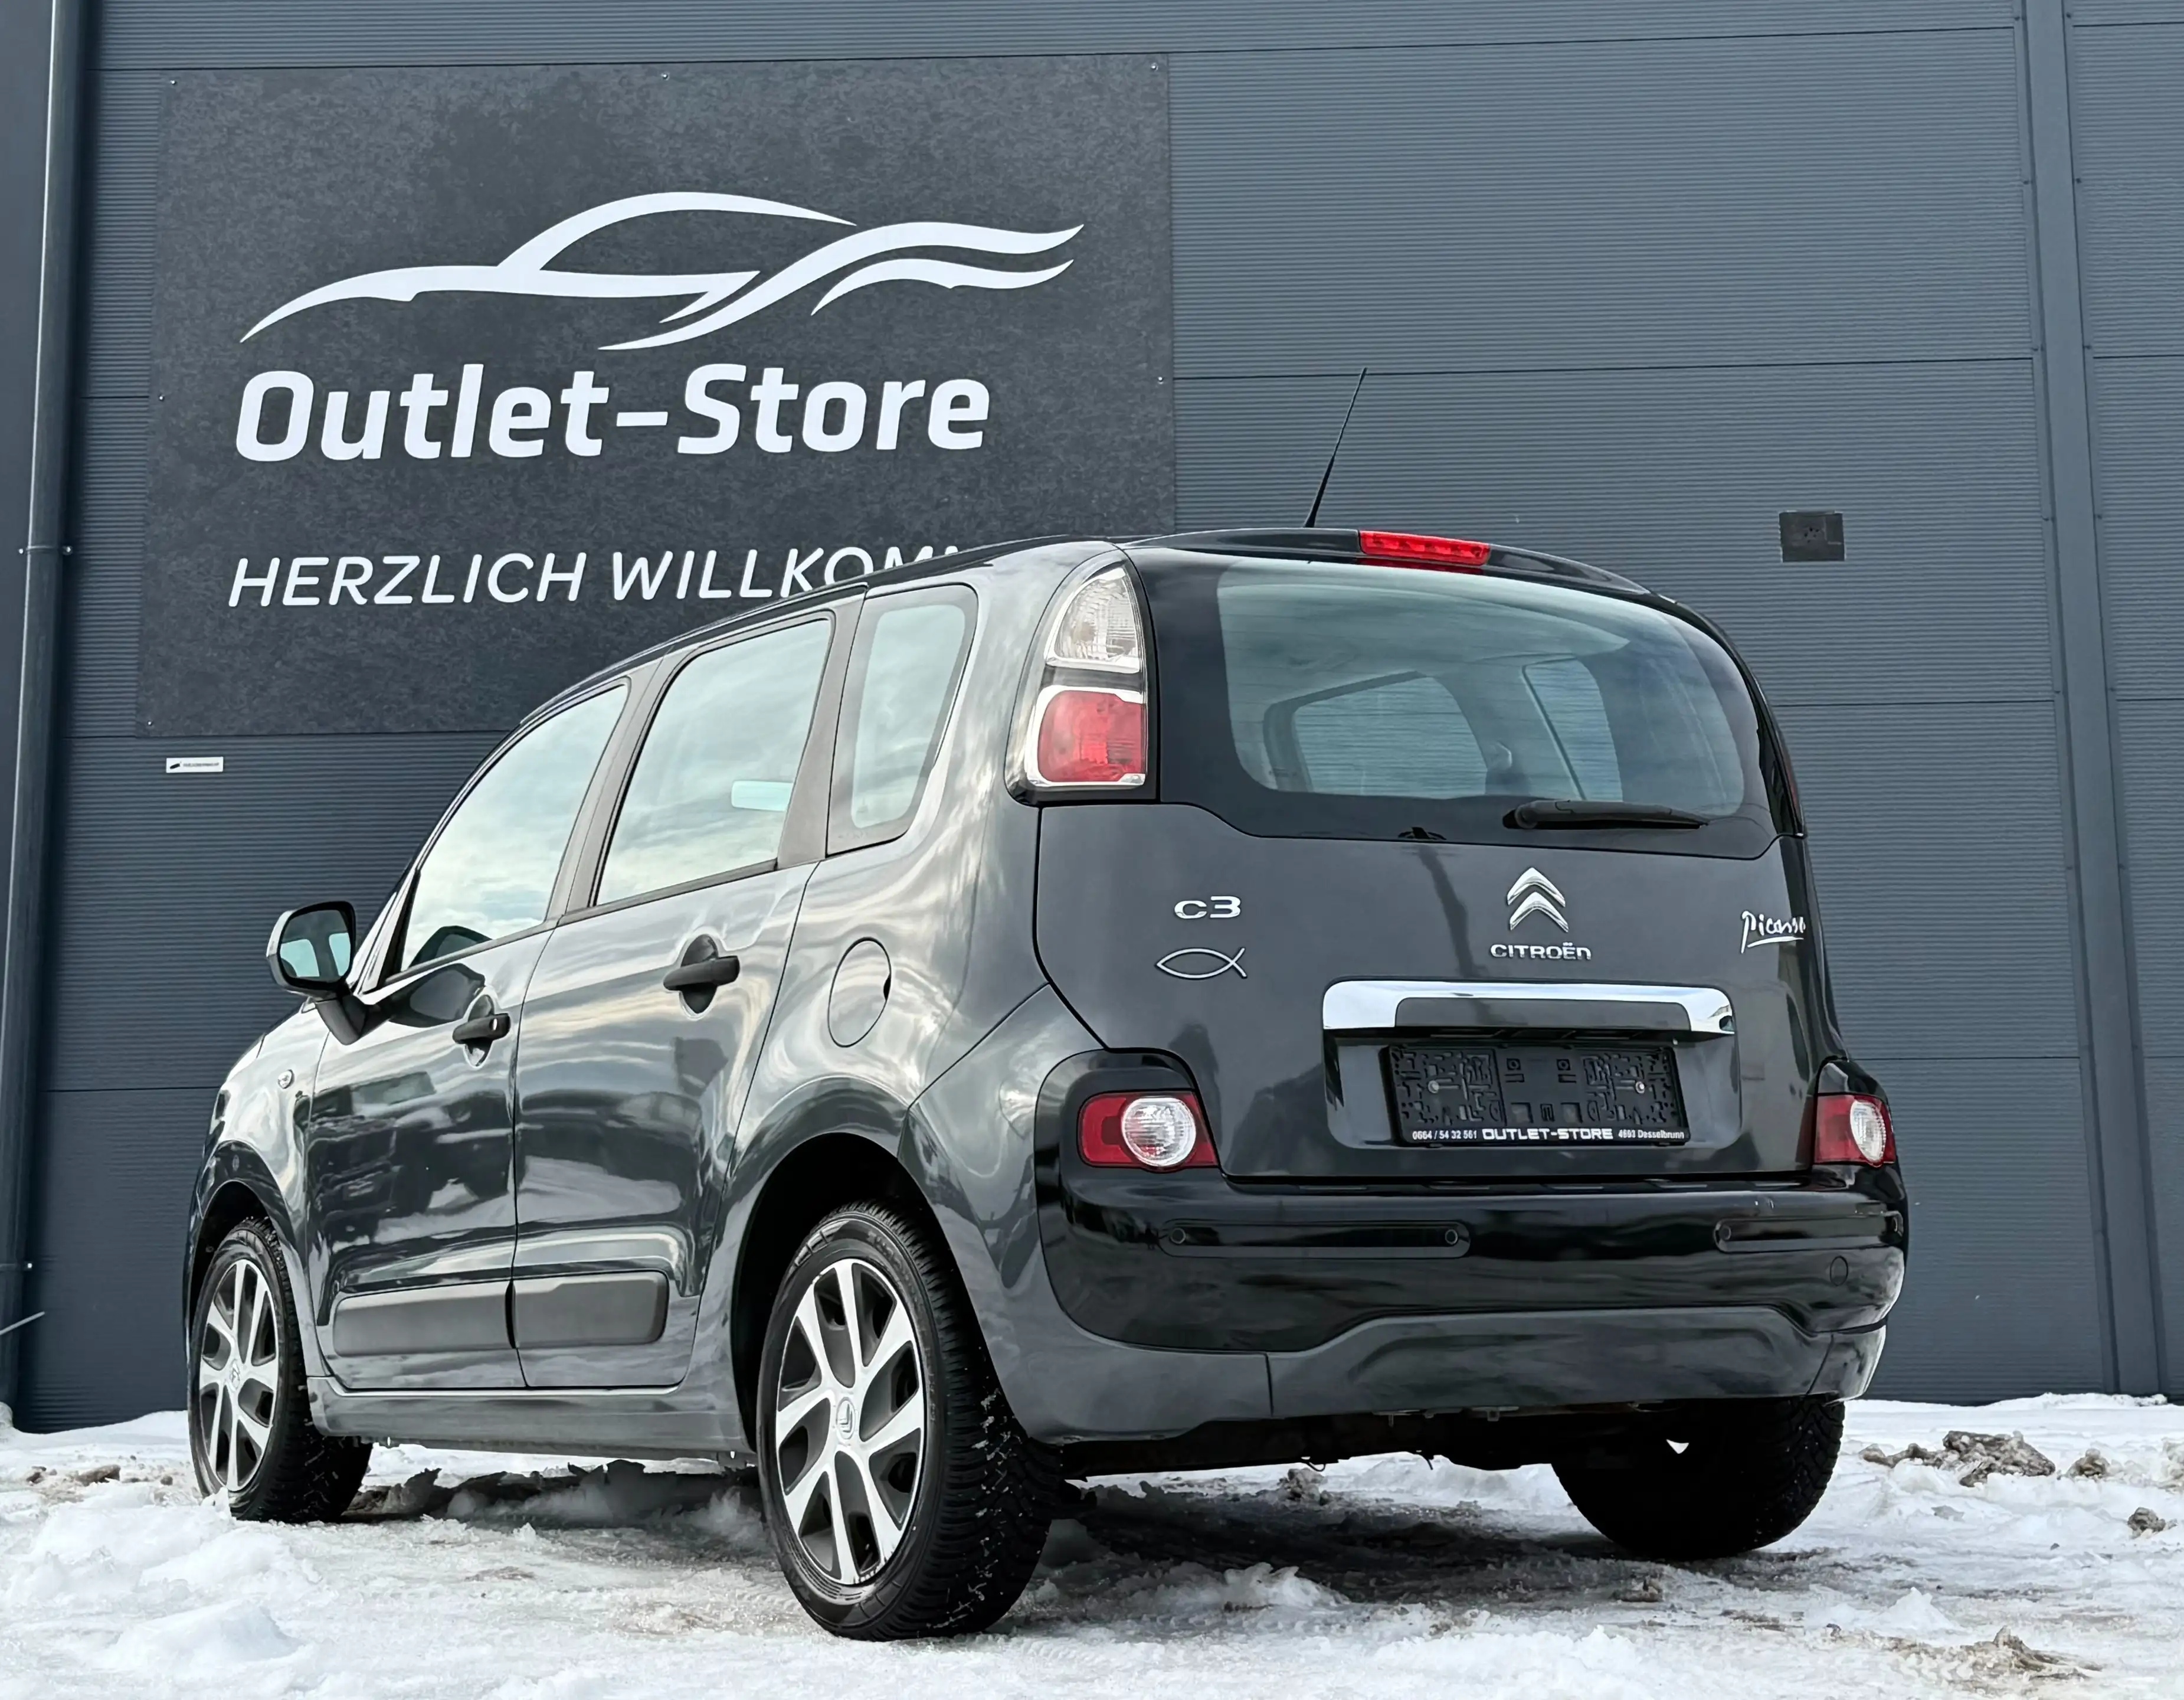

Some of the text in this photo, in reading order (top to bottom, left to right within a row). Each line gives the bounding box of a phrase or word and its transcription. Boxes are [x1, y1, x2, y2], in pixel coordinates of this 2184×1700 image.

[235, 362, 990, 462] Outlet-Store
[228, 545, 959, 607] HERZLICH WILLKO
[1174, 895, 1241, 919] C3
[1490, 941, 1592, 960] CITROËN
[1451, 1130, 1462, 1139] 32
[1482, 1128, 1614, 1140] OUTLET-STORE
[1638, 1129, 1685, 1139] Desselbrunn
